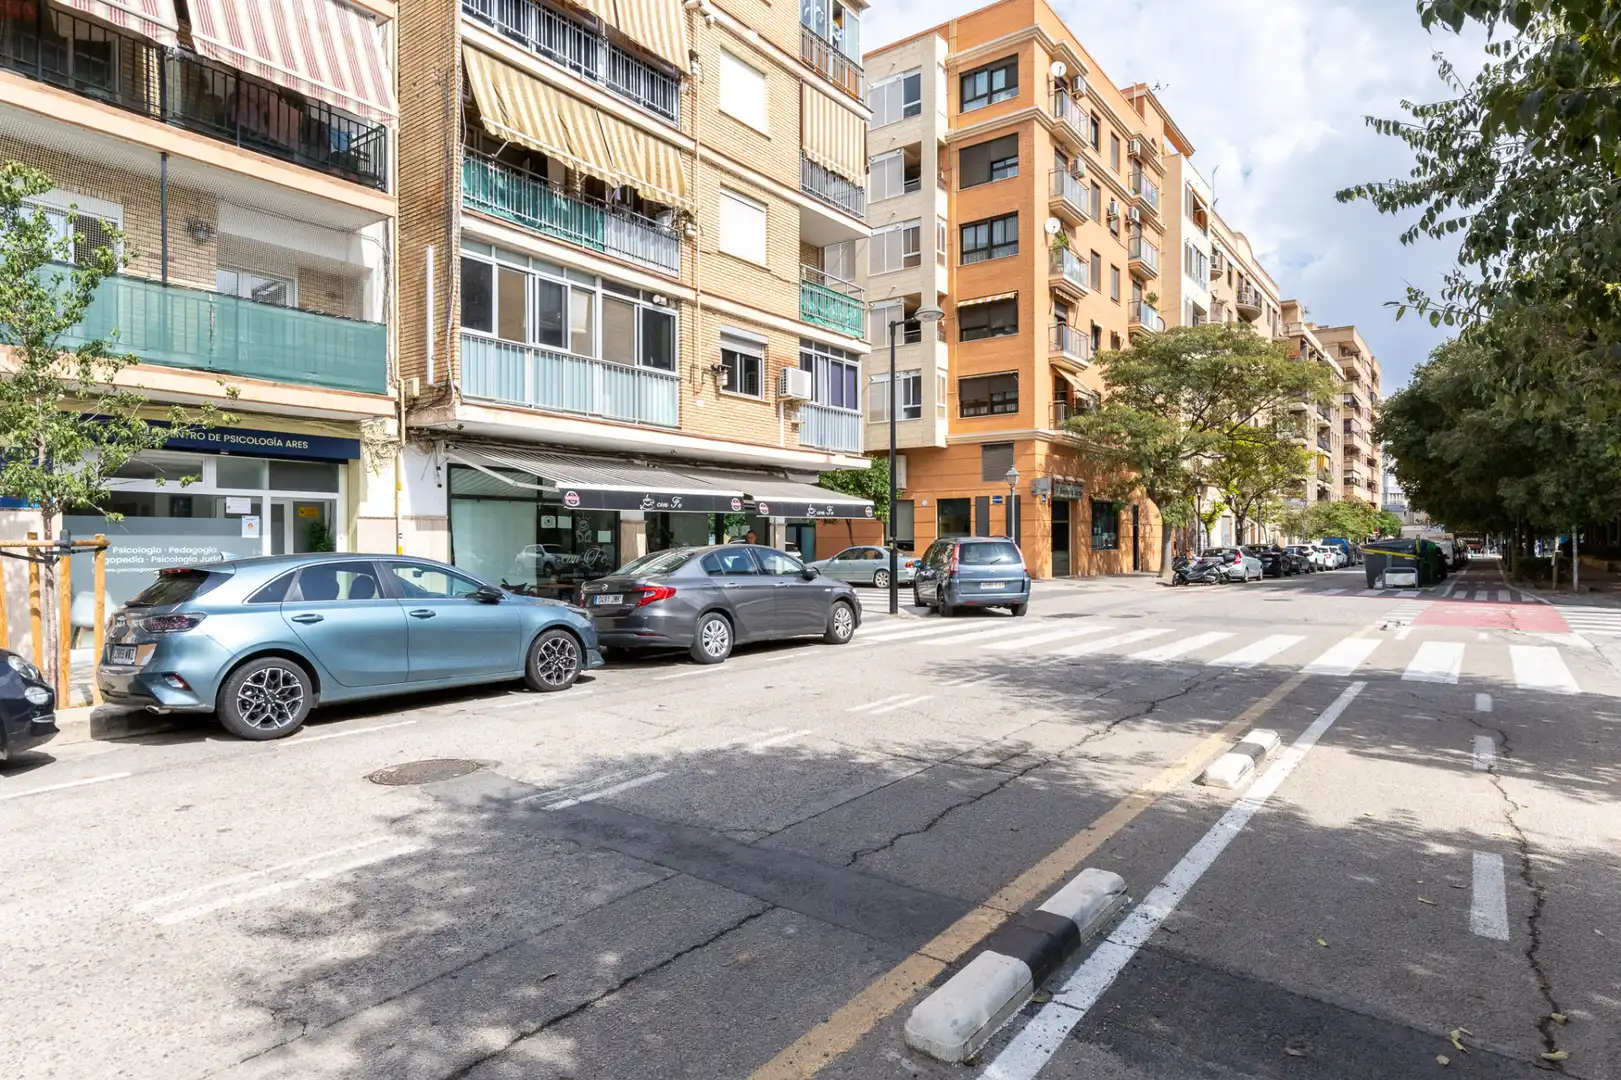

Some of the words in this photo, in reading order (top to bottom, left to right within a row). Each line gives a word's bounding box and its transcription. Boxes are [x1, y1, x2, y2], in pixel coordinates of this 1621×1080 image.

[208, 433, 221, 442] DE
[223, 434, 283, 447] PSICOLOGÍA
[285, 439, 309, 449] ARES
